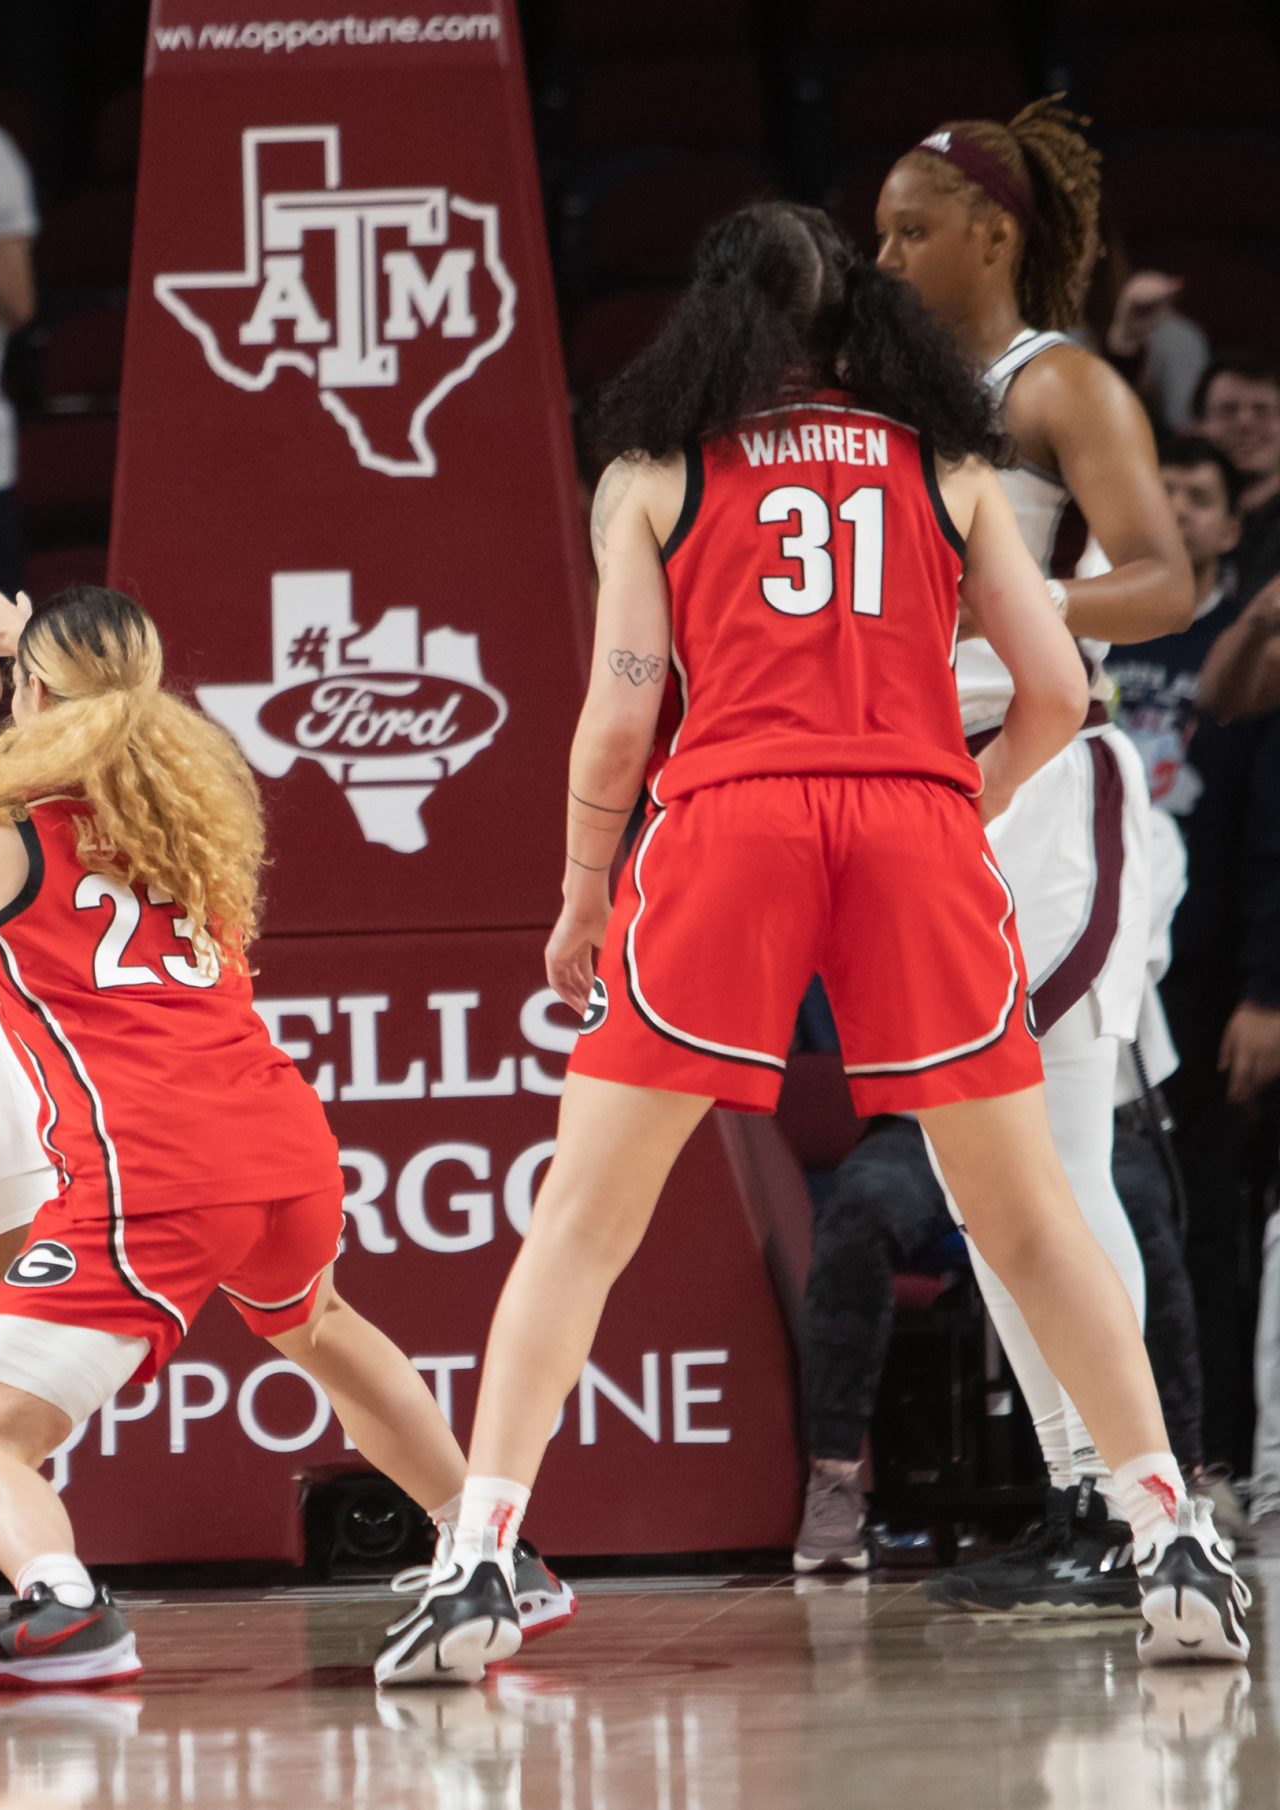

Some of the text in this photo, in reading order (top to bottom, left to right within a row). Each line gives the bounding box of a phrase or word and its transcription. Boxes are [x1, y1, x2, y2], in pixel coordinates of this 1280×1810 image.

[739, 424, 888, 467] WARREN
[757, 485, 884, 618] 31
[295, 678, 463, 748] Ford
[75, 873, 220, 989] 23
[252, 986, 580, 1102] ELLS
[46, 1351, 730, 1494] PPOTNE
